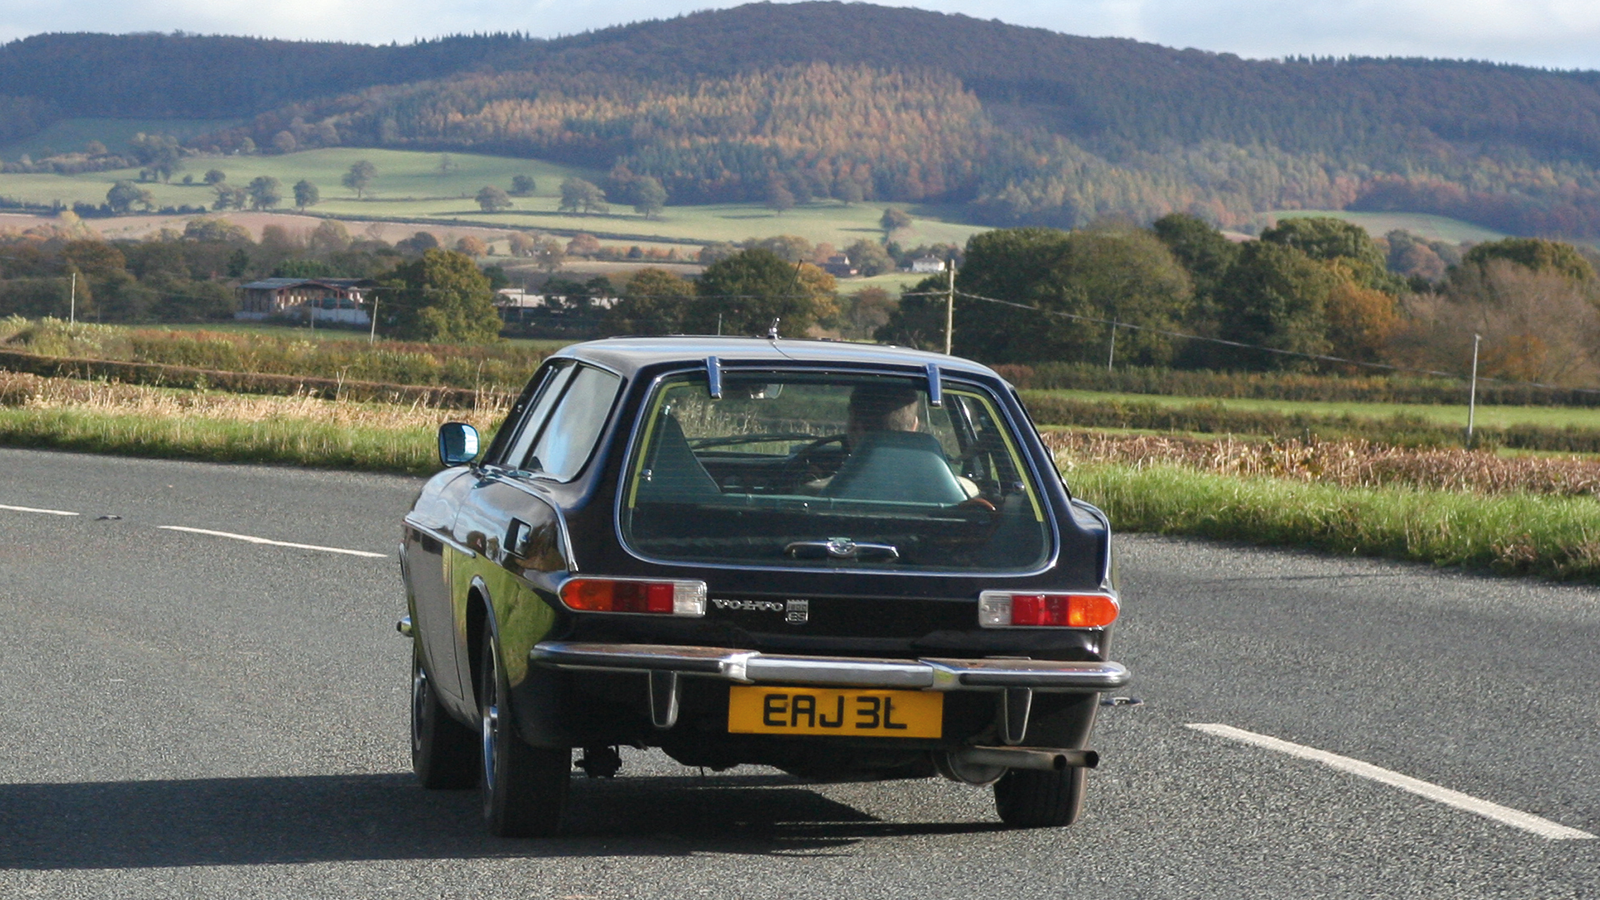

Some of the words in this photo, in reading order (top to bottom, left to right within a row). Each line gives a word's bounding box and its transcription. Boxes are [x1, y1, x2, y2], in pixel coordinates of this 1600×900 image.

[712, 599, 784, 611] VOLVO
[763, 694, 845, 728] EAJ
[855, 696, 907, 730] 3L
